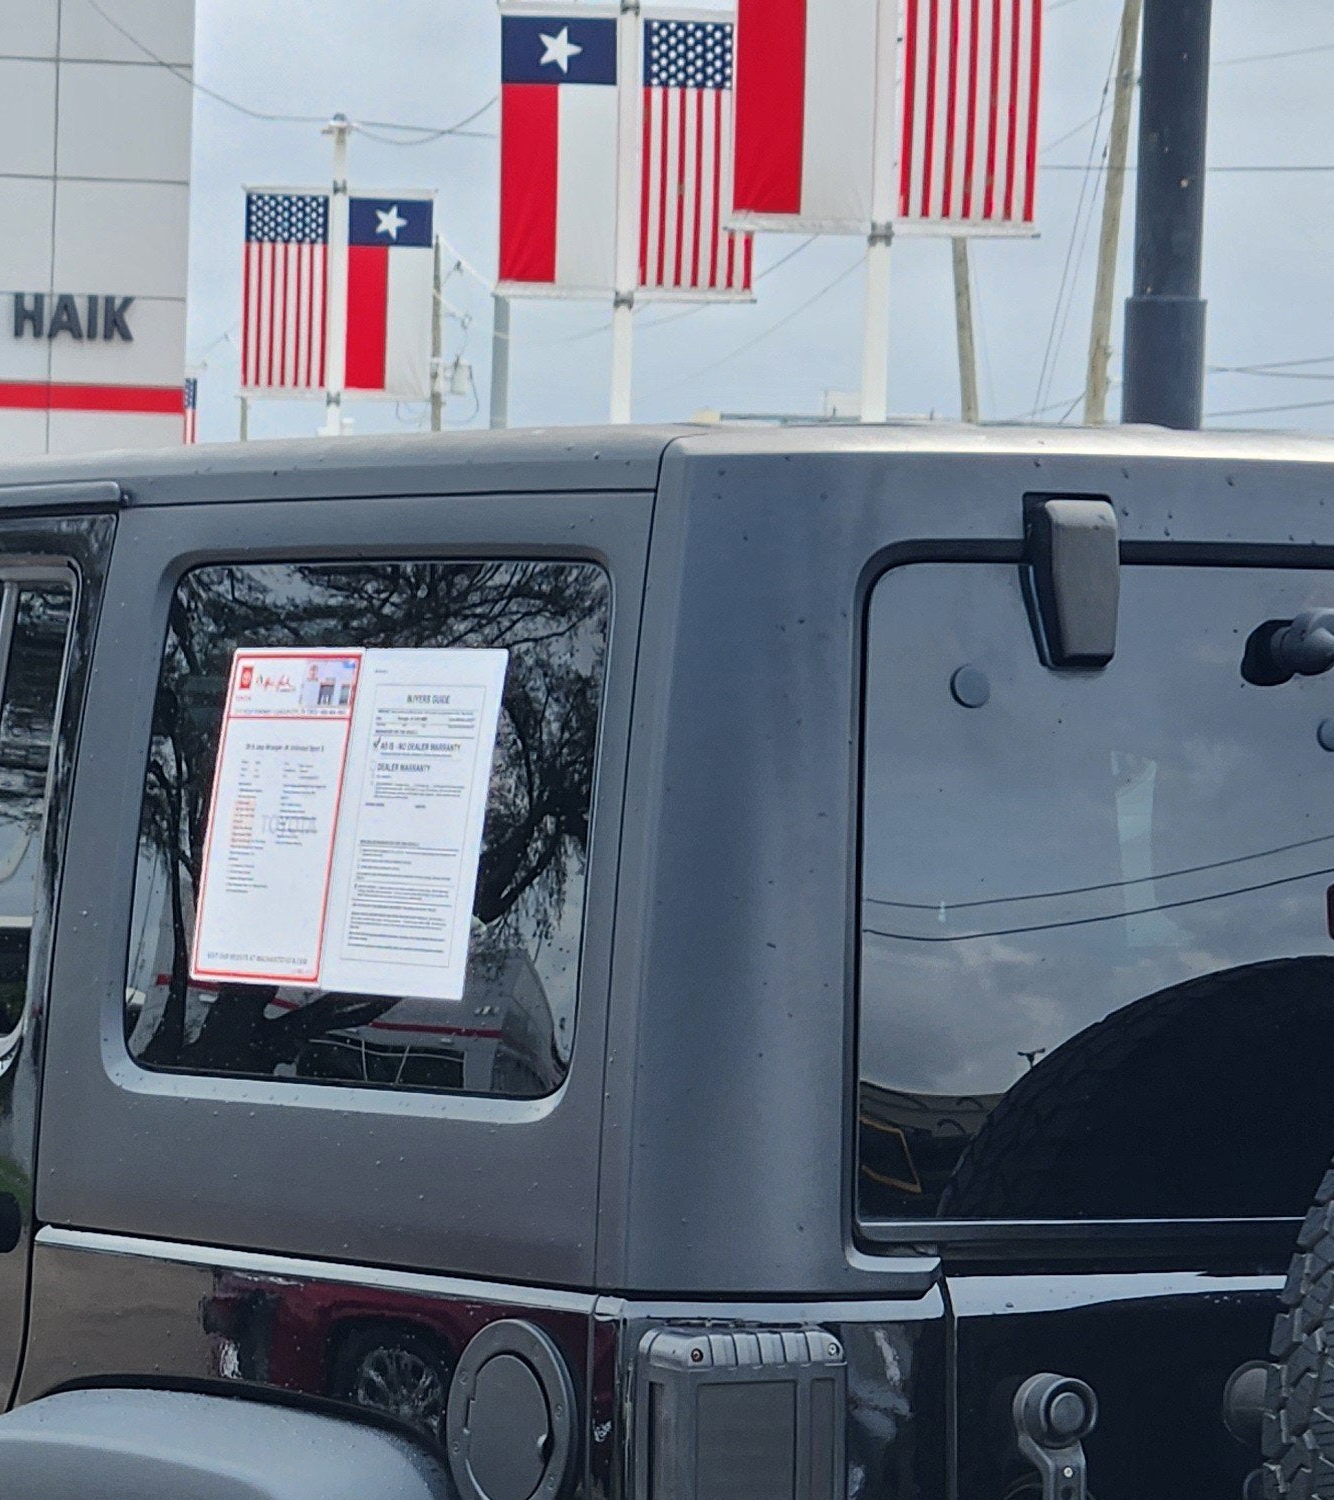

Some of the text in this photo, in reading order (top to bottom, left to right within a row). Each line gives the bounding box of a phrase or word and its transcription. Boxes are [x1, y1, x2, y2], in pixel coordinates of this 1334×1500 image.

[13, 291, 137, 344] HAIK
[407, 743, 430, 752] DEALER
[430, 743, 461, 753] WARRANTY
[377, 762, 431, 773] DEALER WARRANTY
